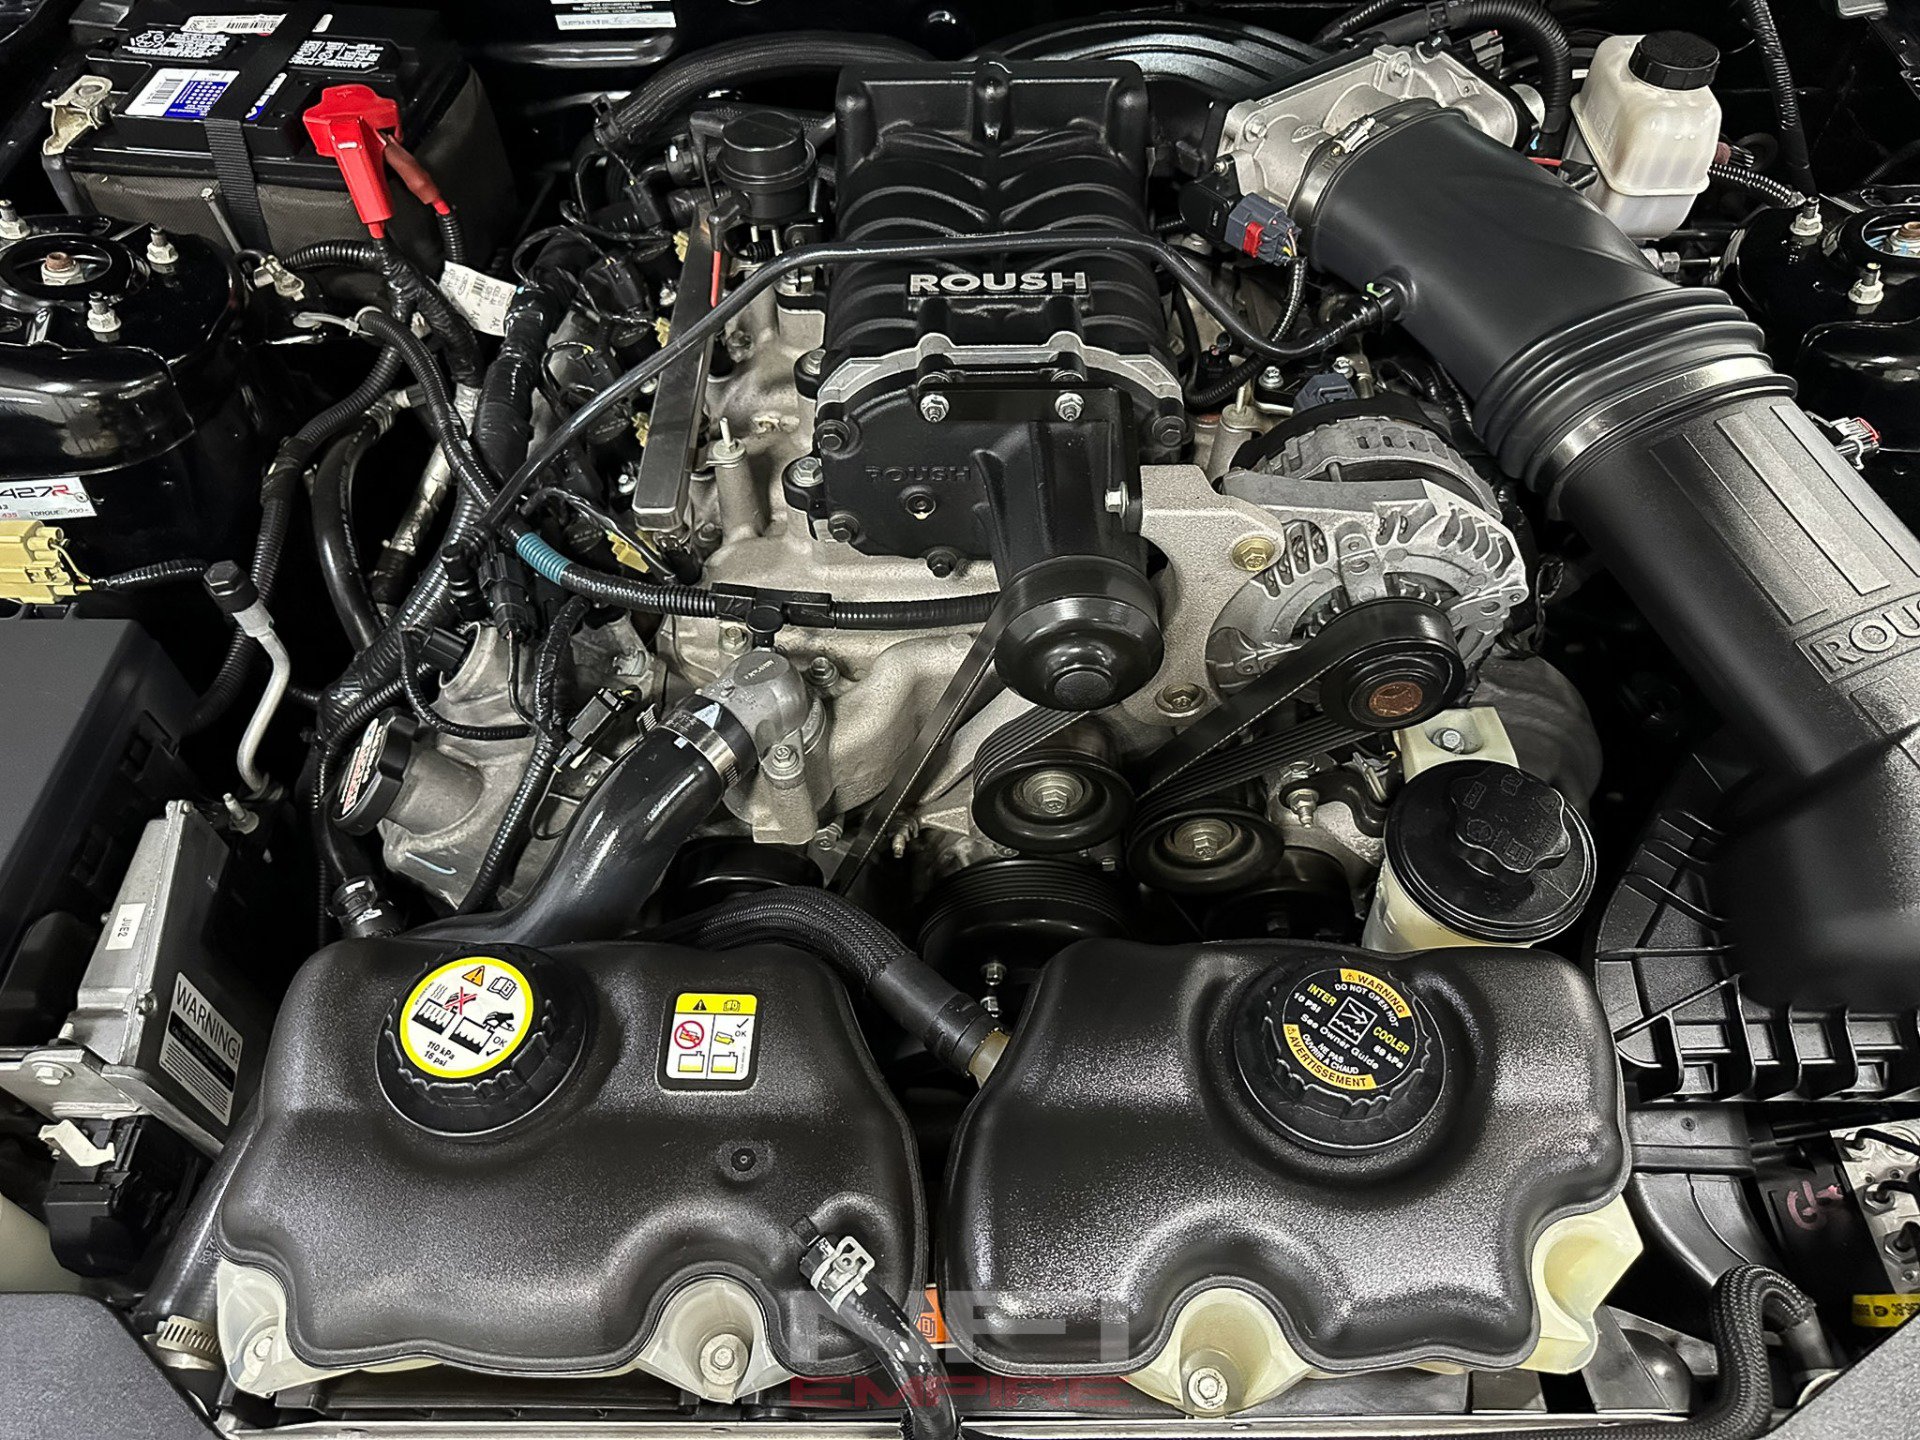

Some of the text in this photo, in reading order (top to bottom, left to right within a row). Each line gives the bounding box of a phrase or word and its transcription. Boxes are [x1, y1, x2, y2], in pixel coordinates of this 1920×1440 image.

[910, 272, 1088, 293] ROUSH
[866, 466, 972, 482] ROUSH
[0, 485, 71, 499] 427R
[1809, 603, 1920, 674] ROU
[1293, 992, 1322, 1013] 10 PSI
[1334, 983, 1399, 1027] DO NOT OPEN HOT
[1358, 975, 1405, 1014] WARNING
[177, 981, 241, 1064] WARNING!
[1307, 983, 1410, 1055] INTER COOLER
[427, 1041, 455, 1060] 110 kPa
[493, 1036, 508, 1048] OK
[1300, 1013, 1379, 1070] See Owner Guide
[424, 1050, 448, 1067] 16 psi
[1290, 1035, 1367, 1087] AVERTISSEMENT
[1329, 1051, 1344, 1063] PAS
[1330, 1061, 1360, 1074] CHAUD
[1386, 1051, 1404, 1069] kPa
